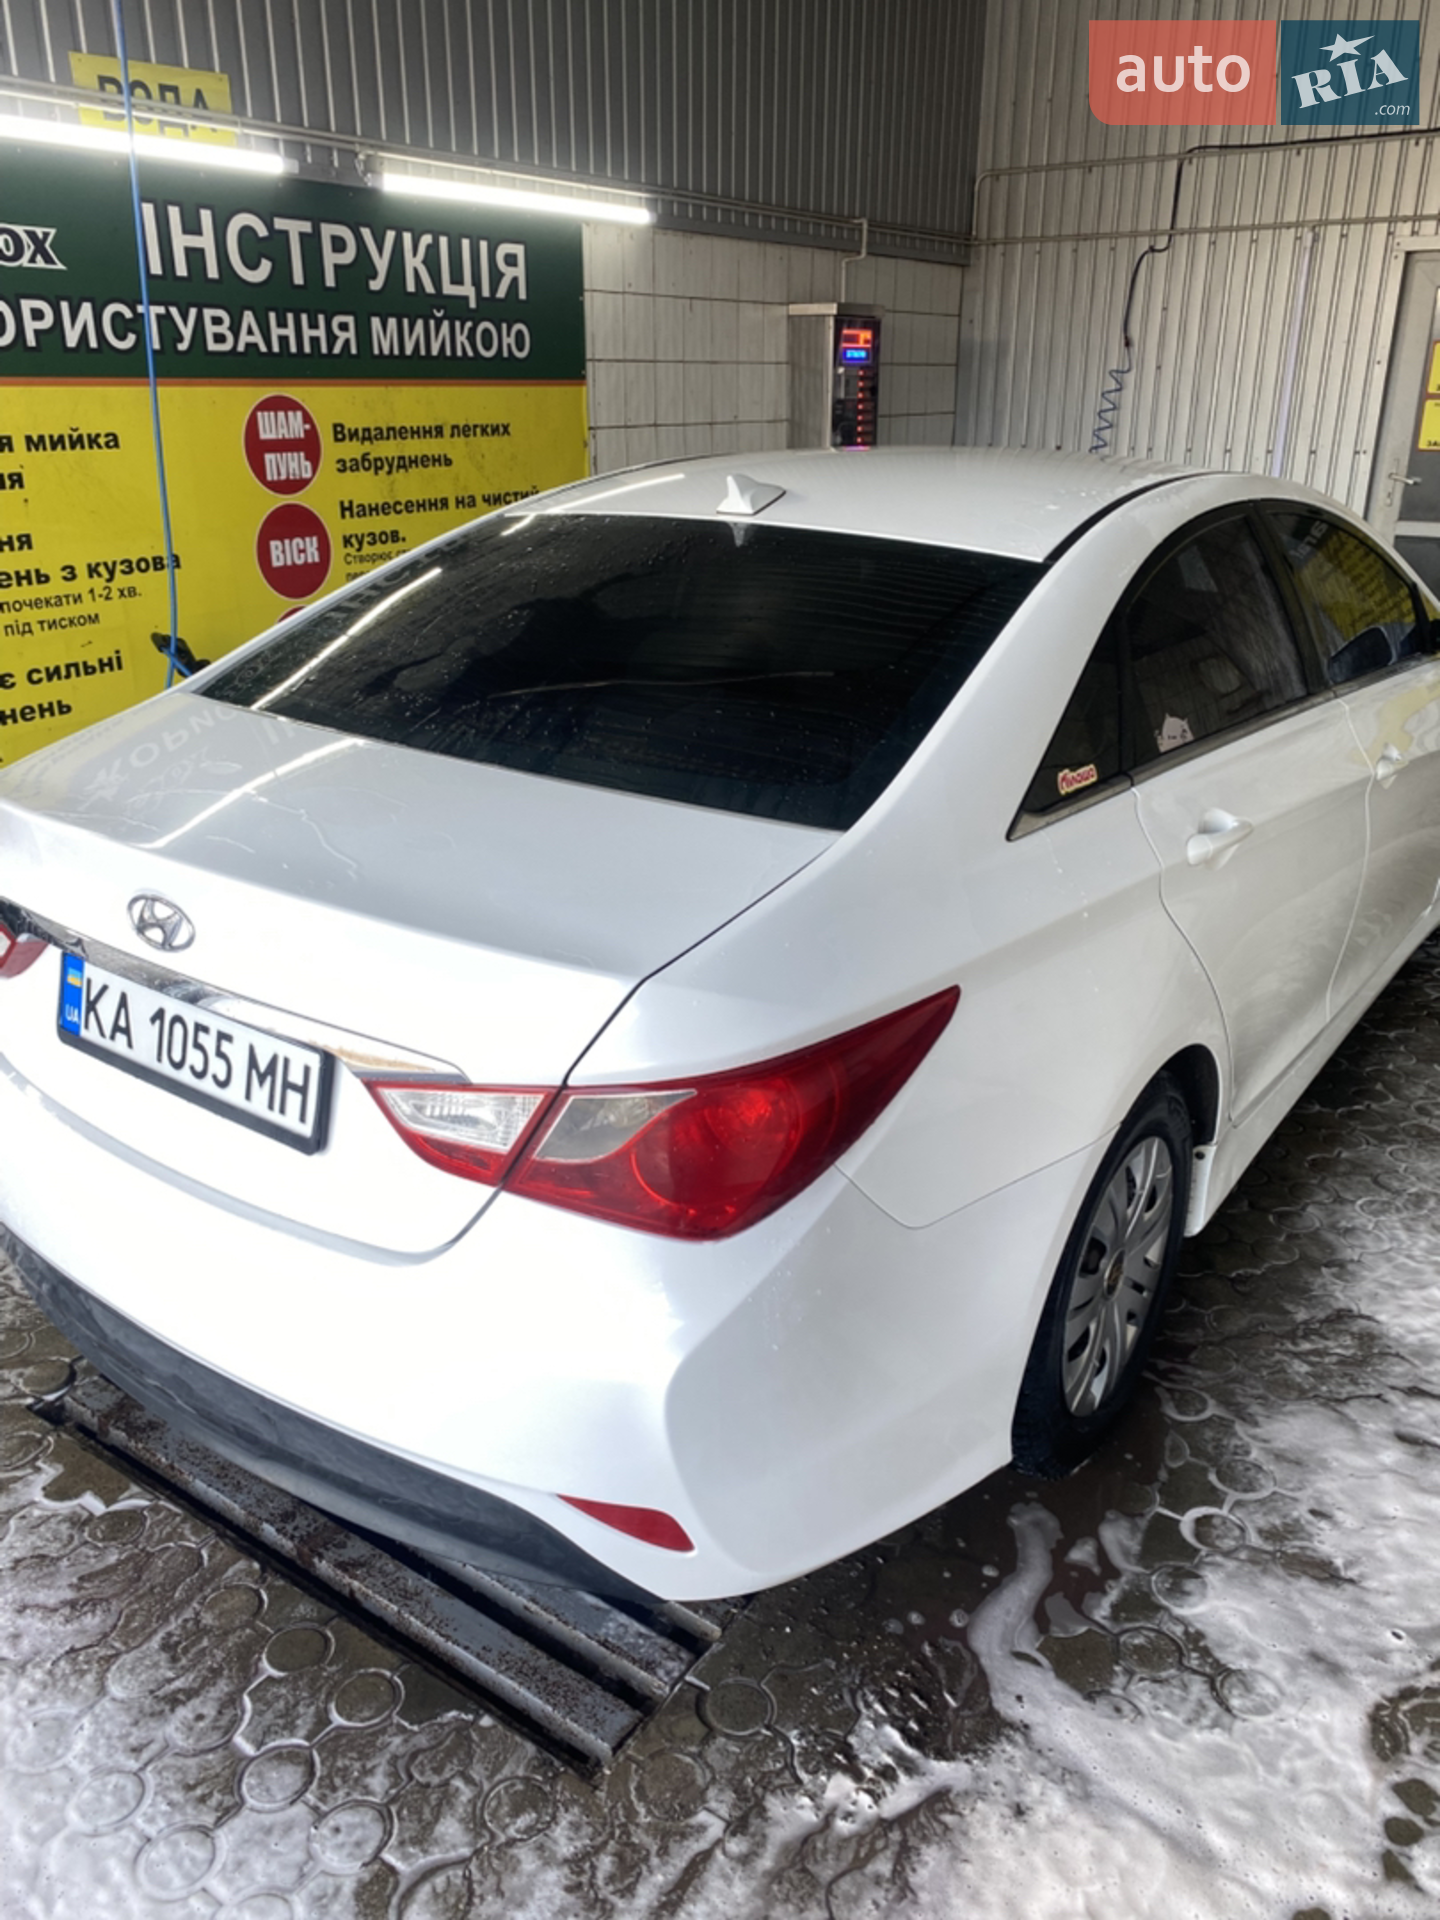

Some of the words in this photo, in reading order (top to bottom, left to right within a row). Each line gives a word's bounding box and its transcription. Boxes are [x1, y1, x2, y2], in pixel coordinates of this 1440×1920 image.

[141, 202, 527, 309] ІНСТРУКЦІЯ
[371, 309, 531, 358] МИЙКОЮ
[257, 410, 310, 440] ШАМ-
[332, 422, 444, 444] Видалення
[449, 421, 511, 439] легких
[25, 427, 120, 453] мийка
[264, 452, 313, 481] ПУНЬ
[335, 450, 453, 476] забруднень
[339, 496, 449, 519] Нанесення
[455, 495, 476, 509] на
[269, 536, 320, 568] ВІСК
[343, 529, 406, 552] кузов.
[60, 564, 77, 582] з
[88, 586, 113, 602] 1-2
[117, 586, 142, 600] хв.
[4, 619, 34, 637] під
[37, 613, 100, 632] тиском
[26, 649, 123, 686] сильні
[65, 1003, 80, 1025] UA
[150, 1007, 234, 1089] 1055
